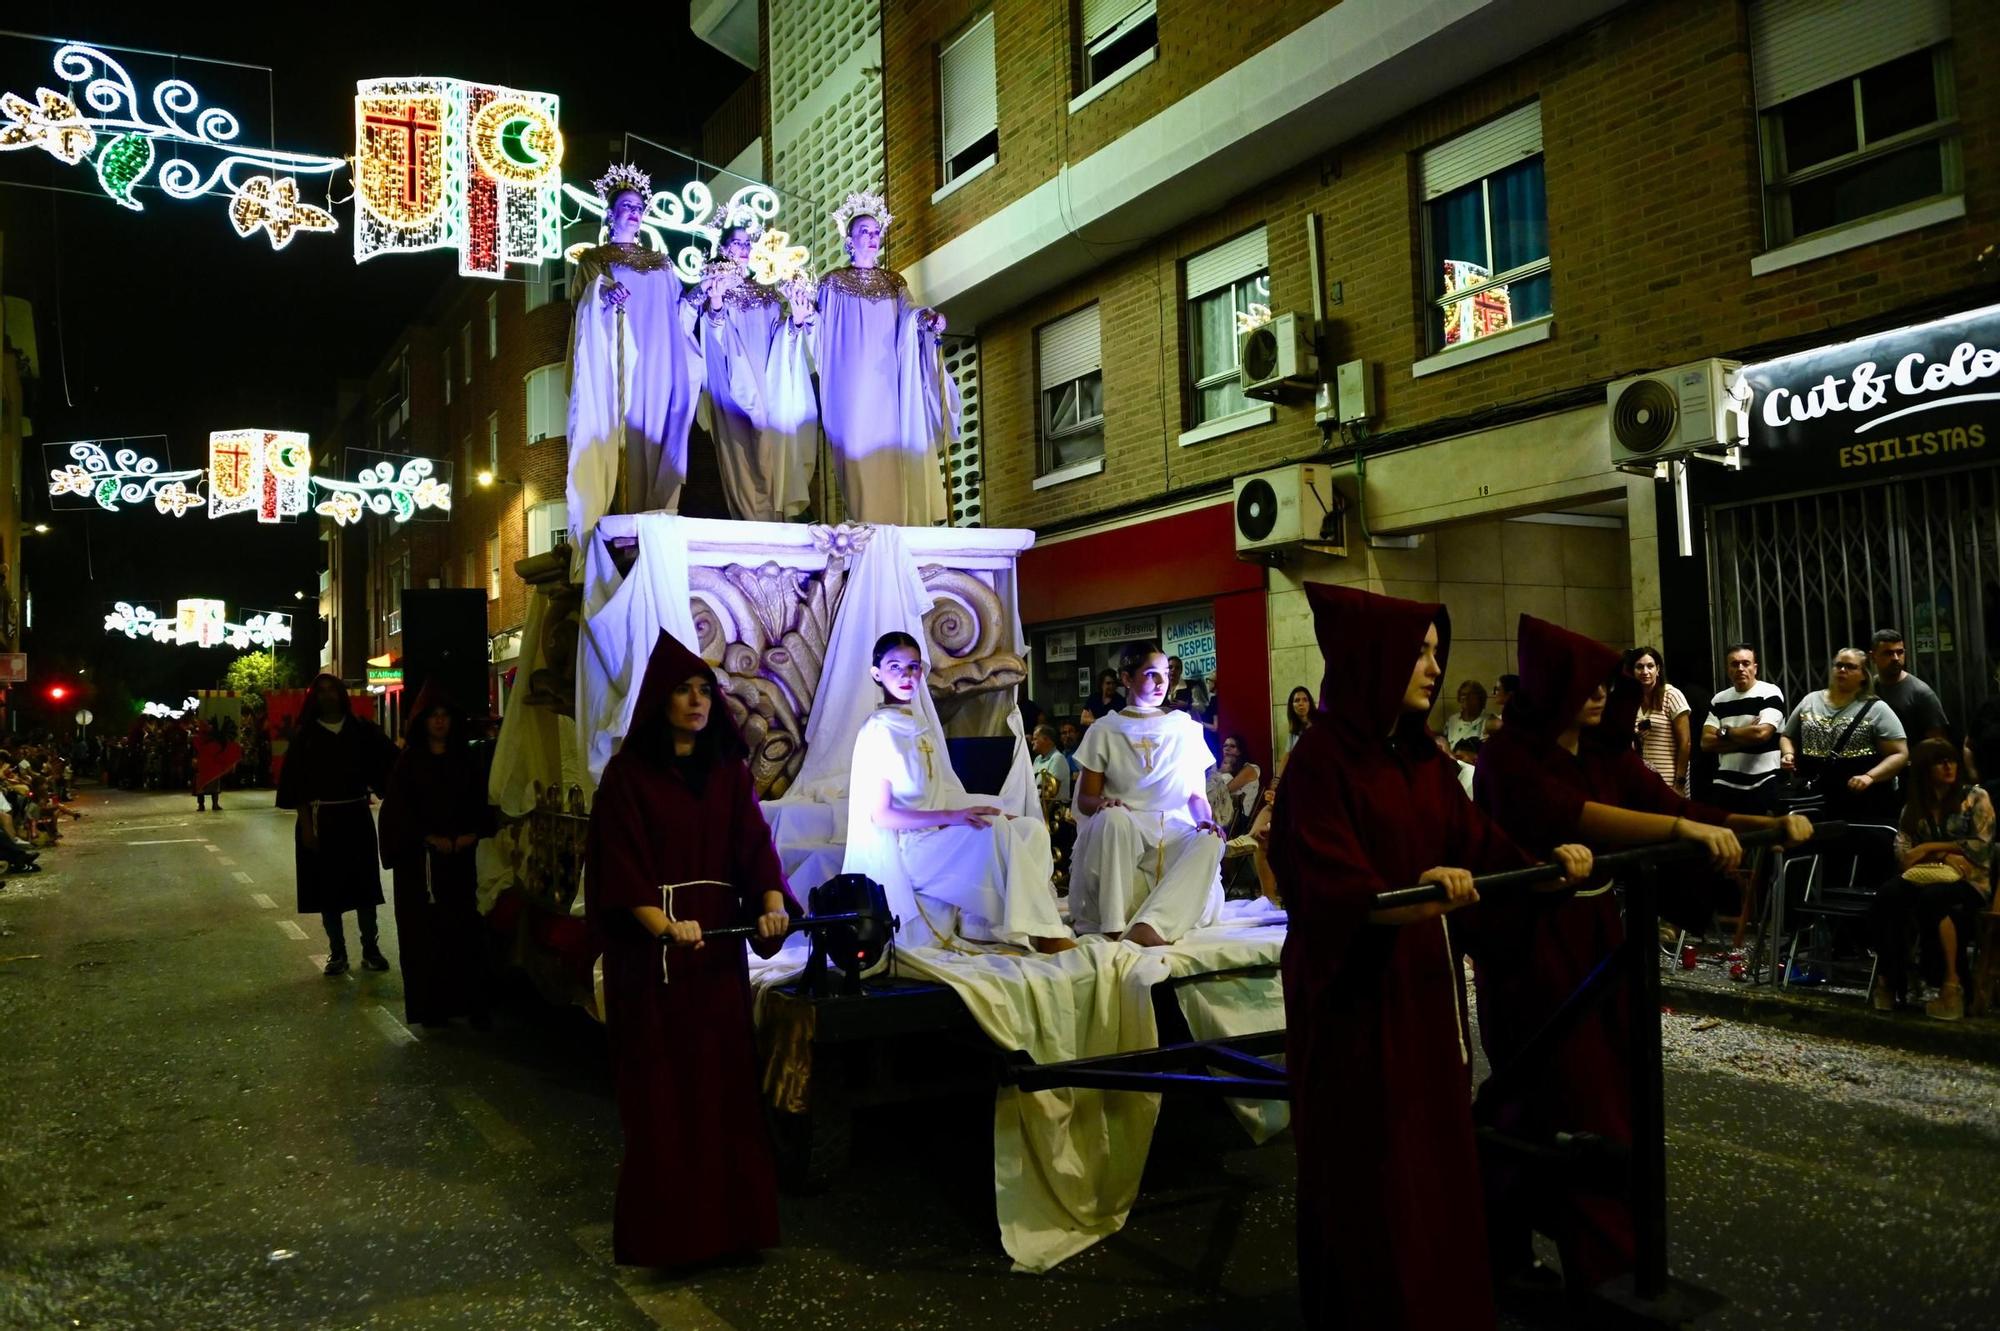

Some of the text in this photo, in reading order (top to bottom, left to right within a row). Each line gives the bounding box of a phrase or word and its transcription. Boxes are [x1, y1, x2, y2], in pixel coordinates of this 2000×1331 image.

[1839, 423, 1987, 468] ESTILISTAS
[1478, 485, 1489, 496] 18
[1167, 616, 1216, 641] CAMISETAS
